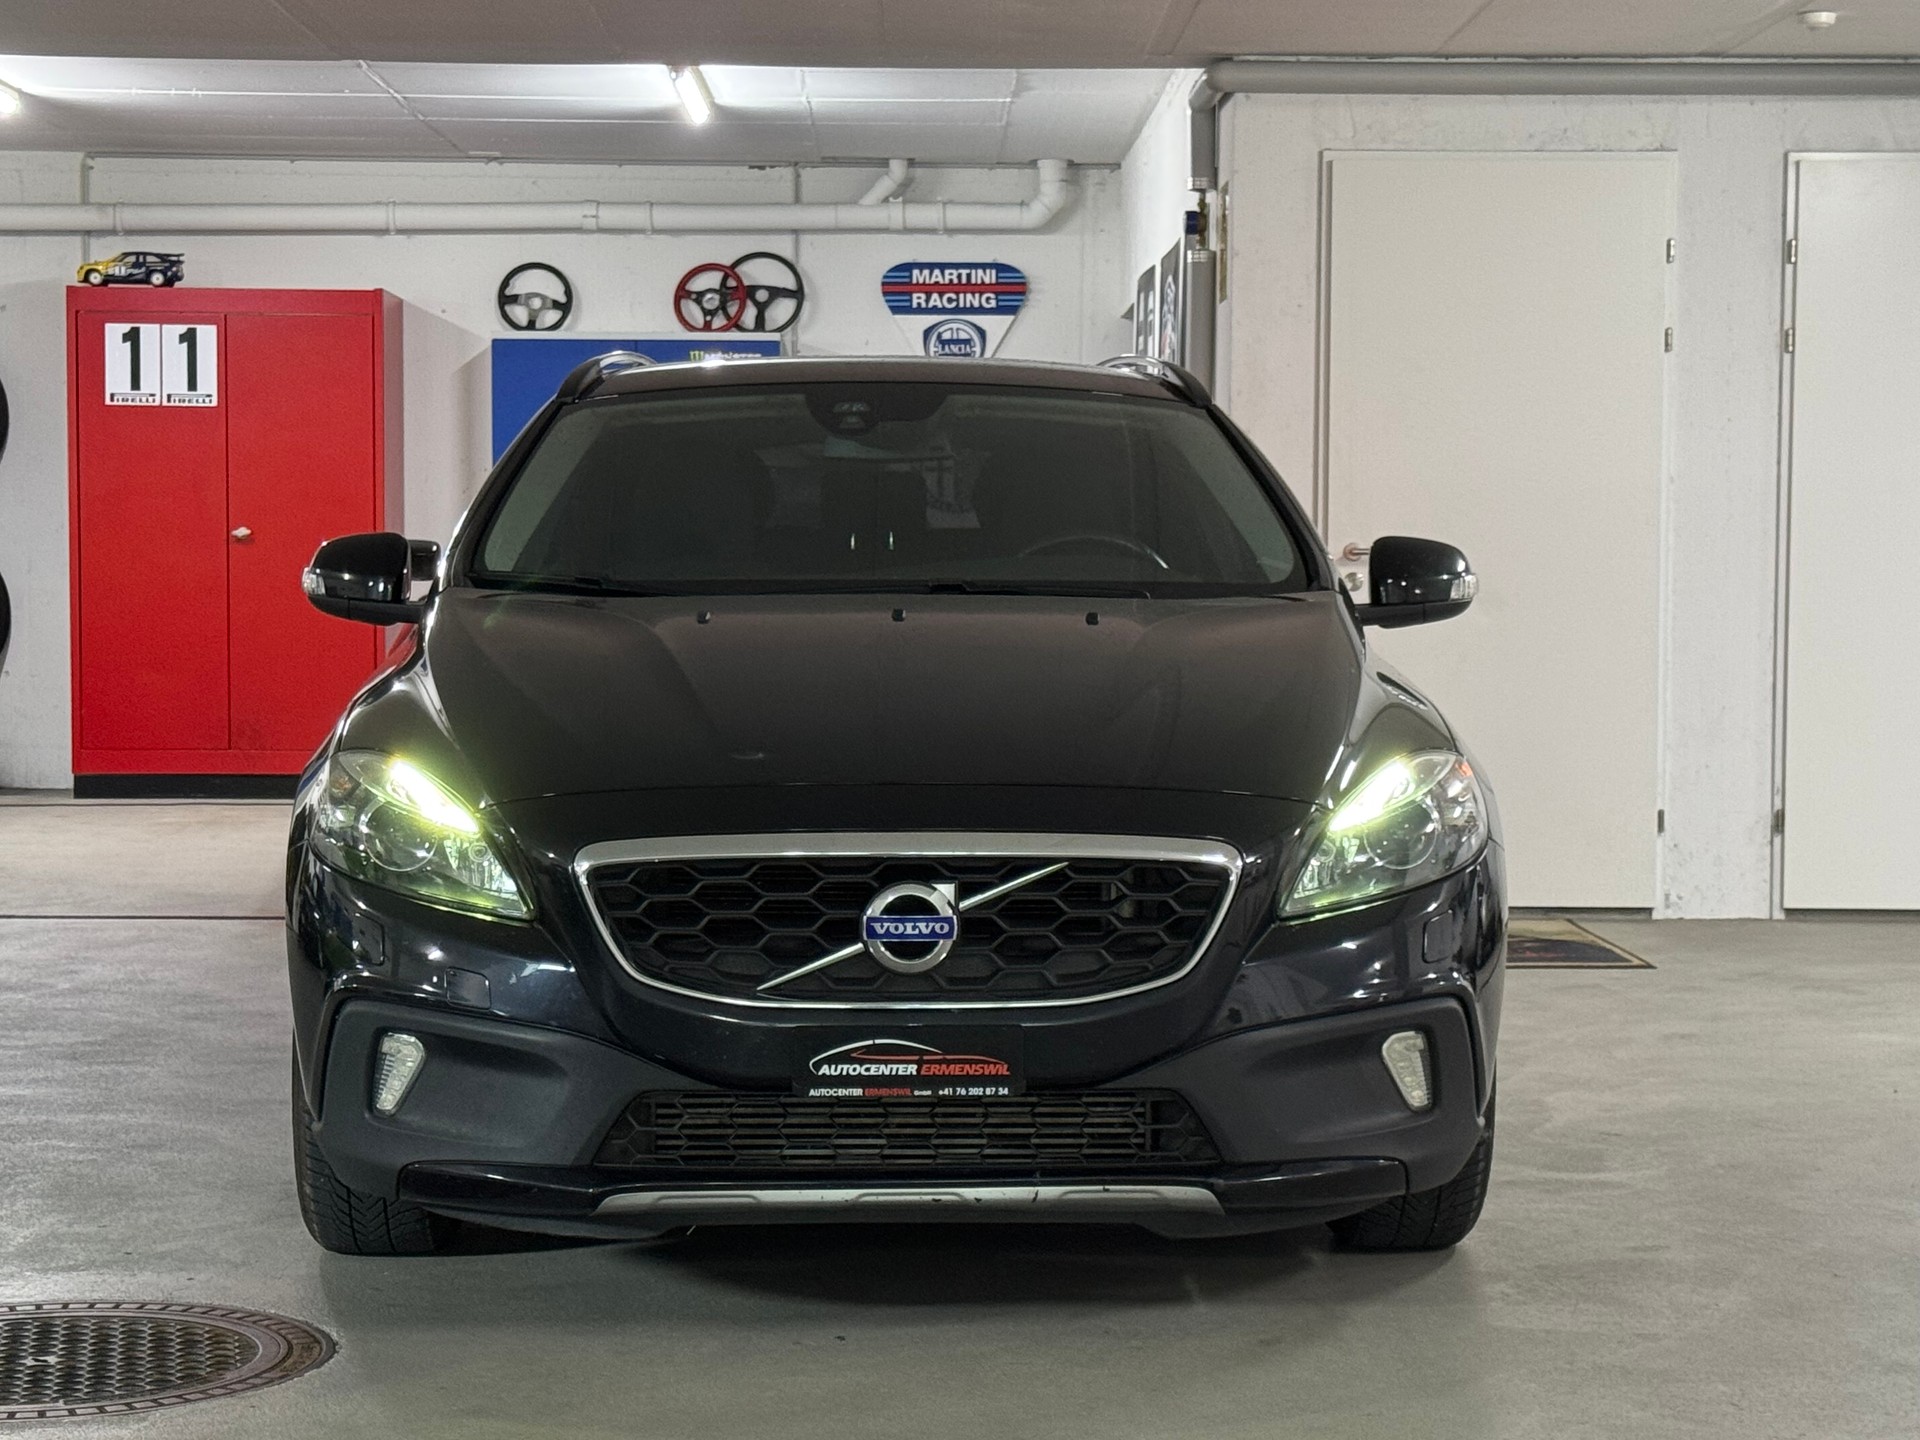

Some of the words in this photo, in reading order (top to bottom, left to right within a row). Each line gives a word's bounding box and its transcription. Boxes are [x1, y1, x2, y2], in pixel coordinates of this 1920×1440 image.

[911, 268, 997, 284] MARTINI
[911, 292, 997, 309] RACING
[110, 393, 157, 403] PIRELLI
[166, 393, 213, 404] PIRELLI
[870, 922, 950, 935] VOLVO
[818, 1064, 918, 1076] AUTOCENTER
[920, 1064, 1011, 1076] ERMENSWIL
[808, 1088, 863, 1097] AUTOCENTER
[864, 1088, 912, 1096] ERMENSWIL
[938, 1087, 953, 1095] +41
[955, 1087, 967, 1095] 76
[968, 1087, 984, 1096] 202
[998, 1087, 1009, 1095] 34
